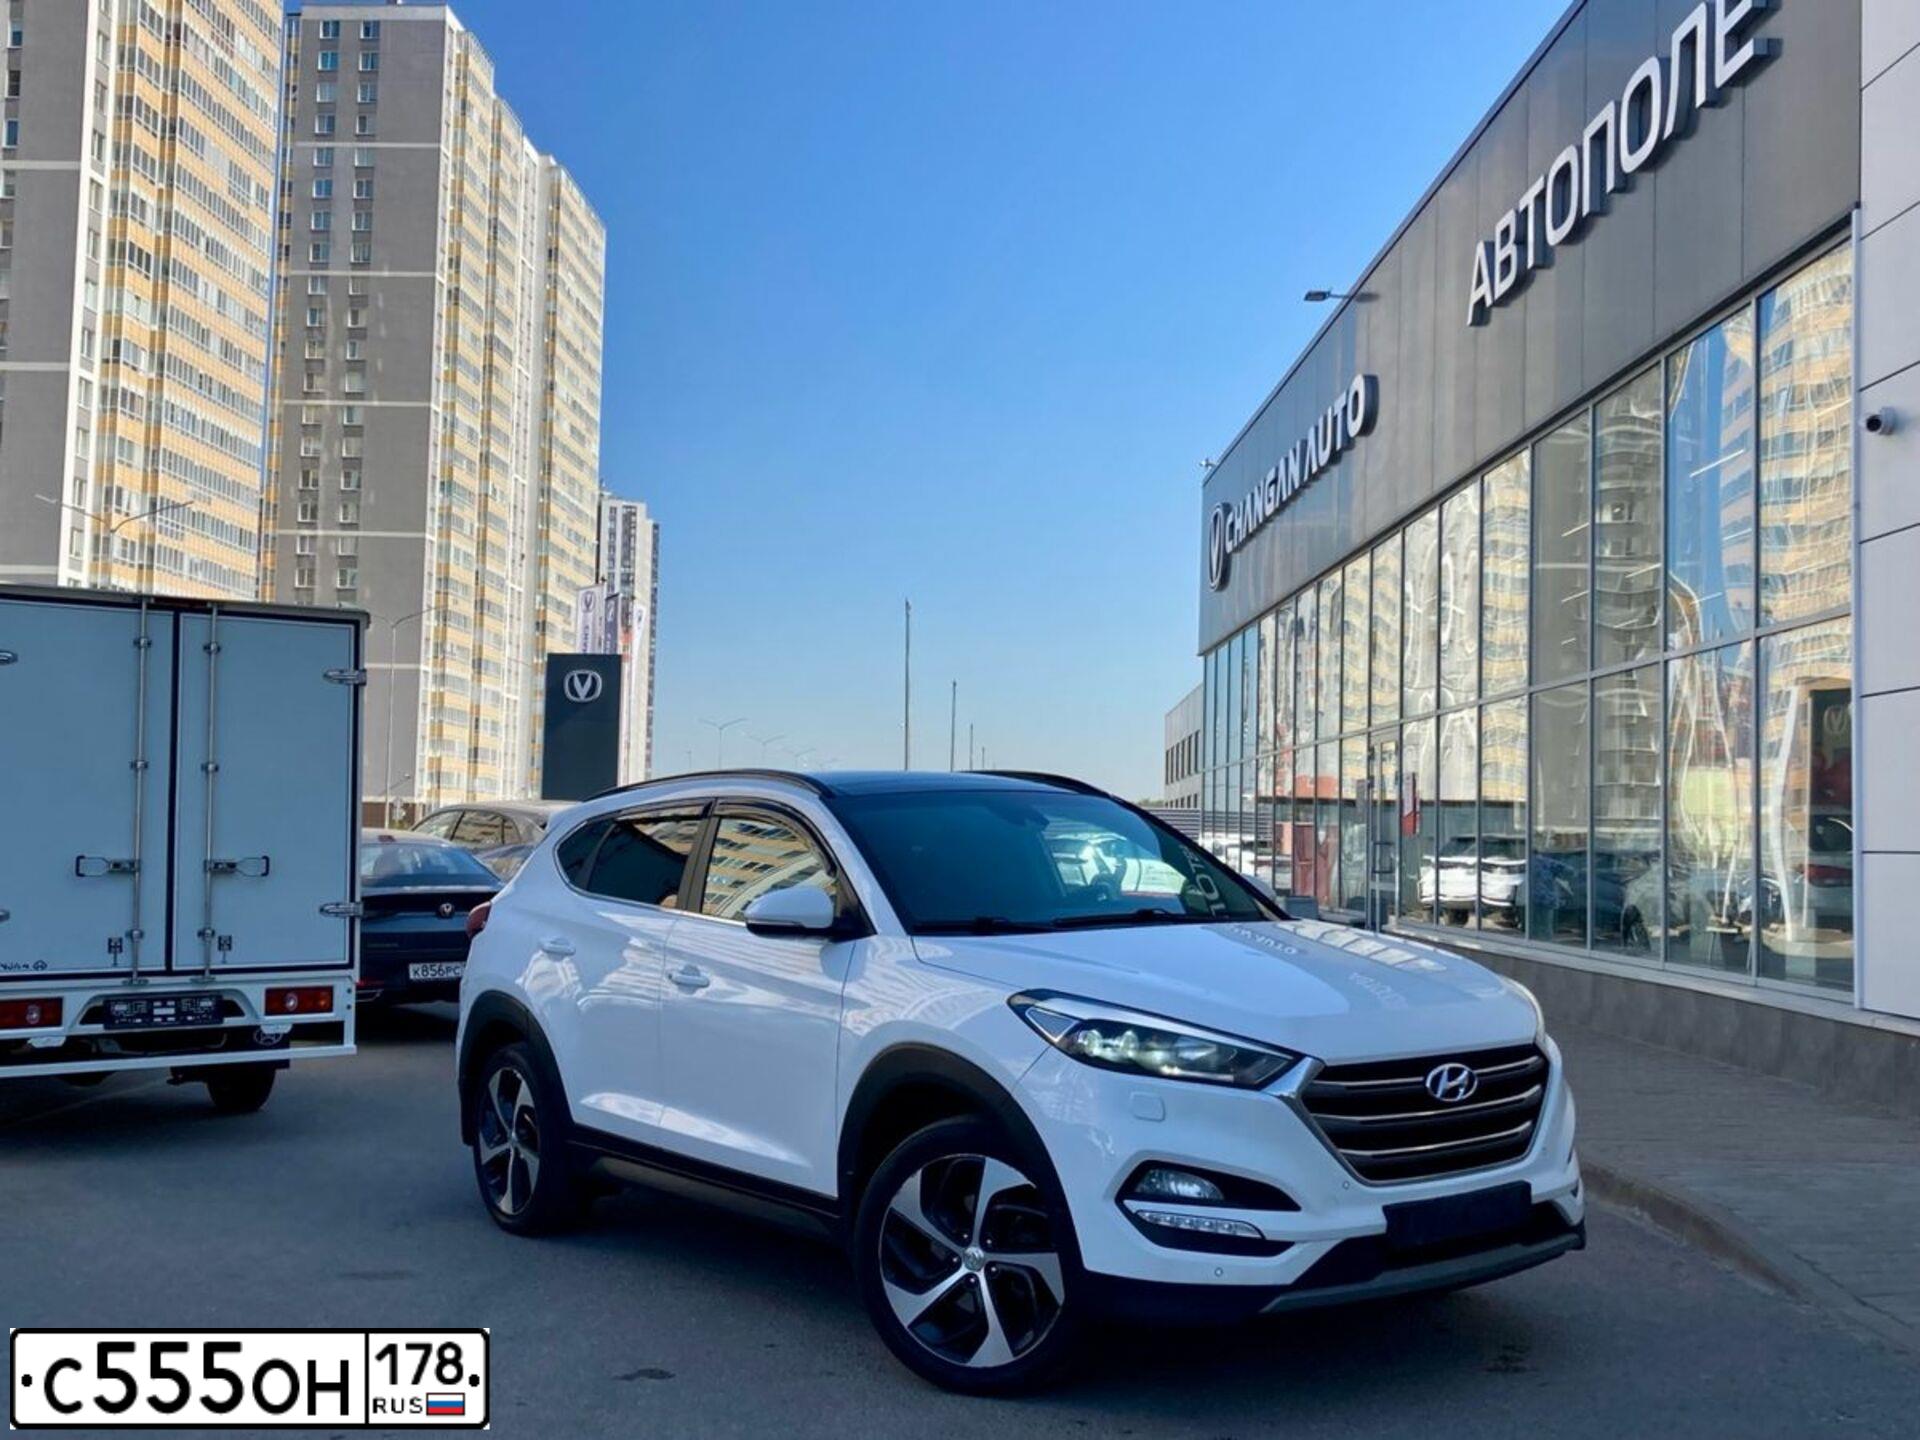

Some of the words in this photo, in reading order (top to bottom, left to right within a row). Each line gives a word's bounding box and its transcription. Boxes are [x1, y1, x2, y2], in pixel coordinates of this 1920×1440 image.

[1467, 0, 1755, 326] АВТОПОЛЕ
[1224, 440, 1301, 554] CHANGAN
[1303, 374, 1365, 481] AUTO
